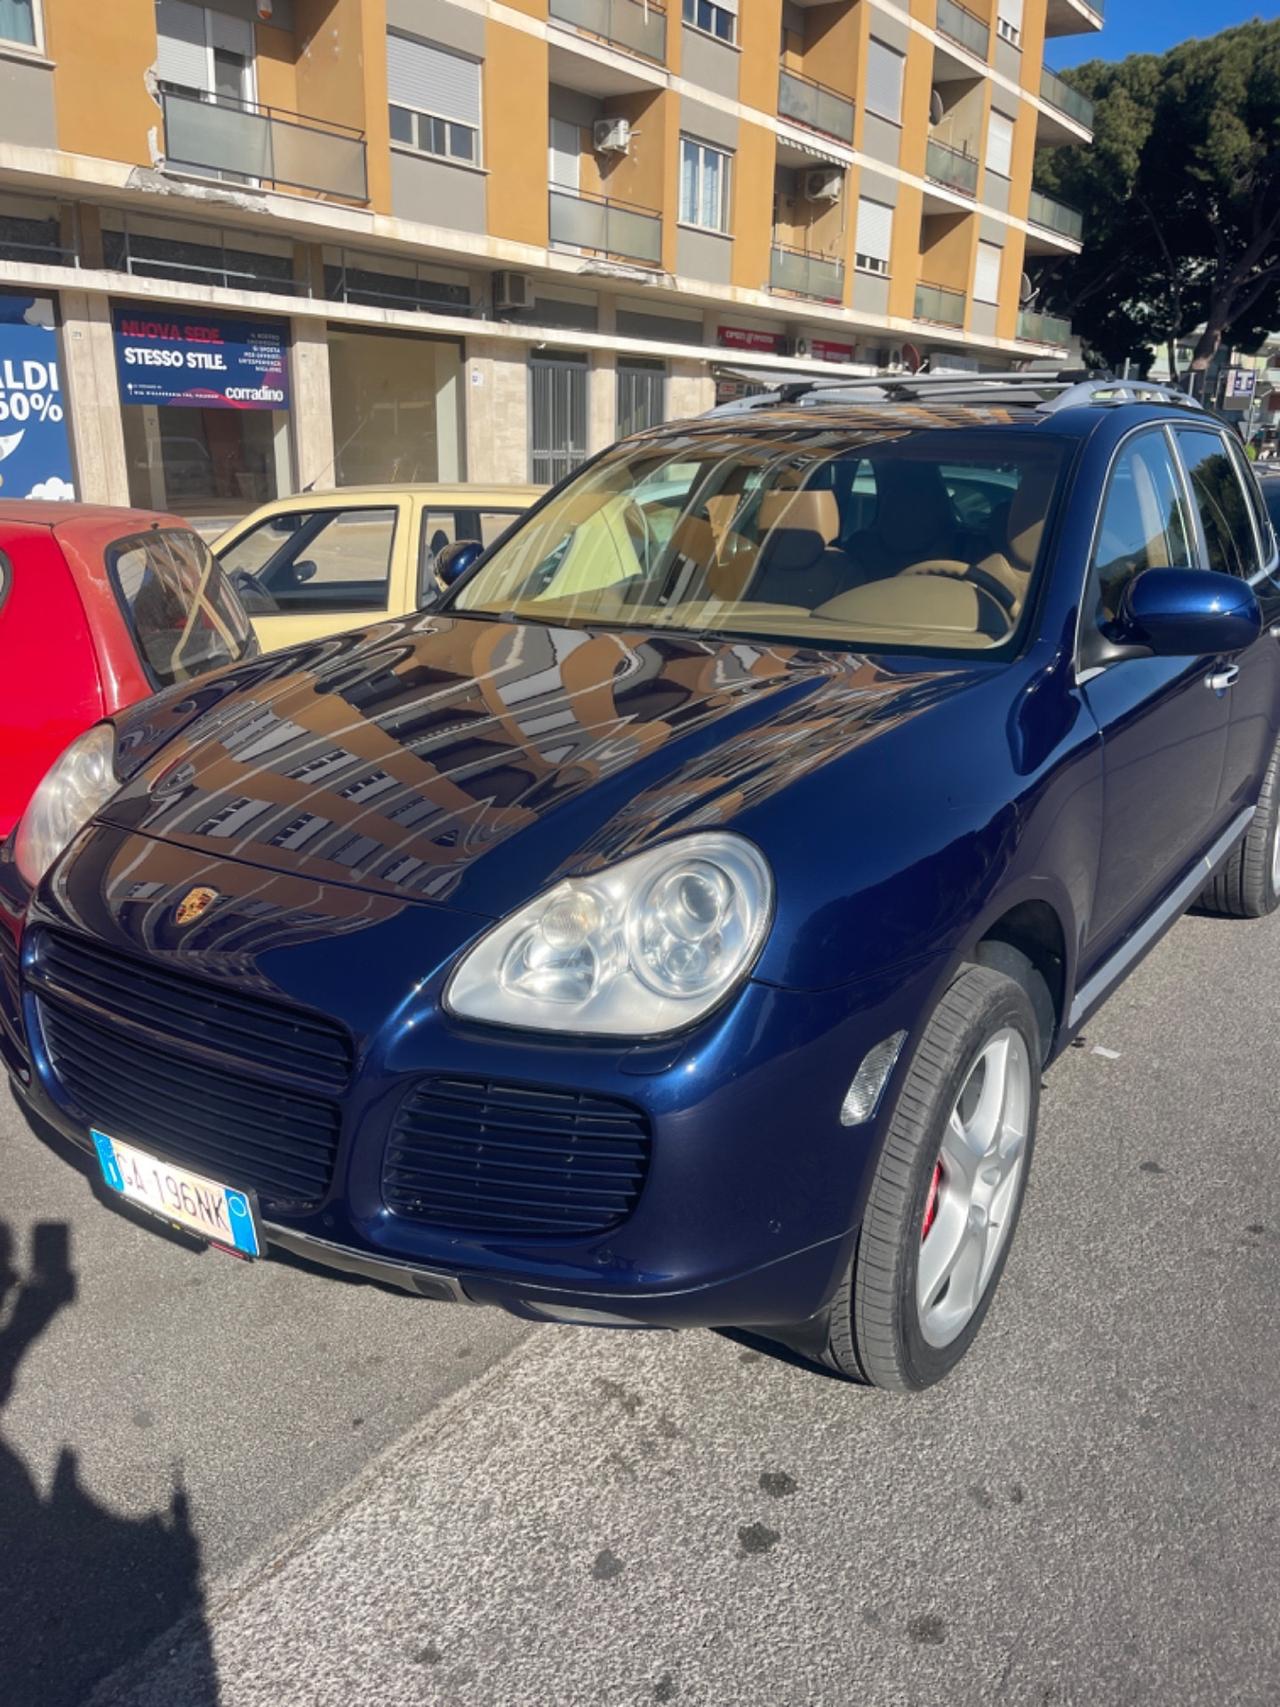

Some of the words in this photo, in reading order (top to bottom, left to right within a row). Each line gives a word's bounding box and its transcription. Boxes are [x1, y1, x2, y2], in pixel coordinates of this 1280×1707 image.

[121, 320, 183, 342] NUOVA
[124, 346, 184, 368] STESSO
[186, 352, 228, 371] STILE.
[225, 385, 284, 402] corradino
[153, 1171, 229, 1232] 196NK
